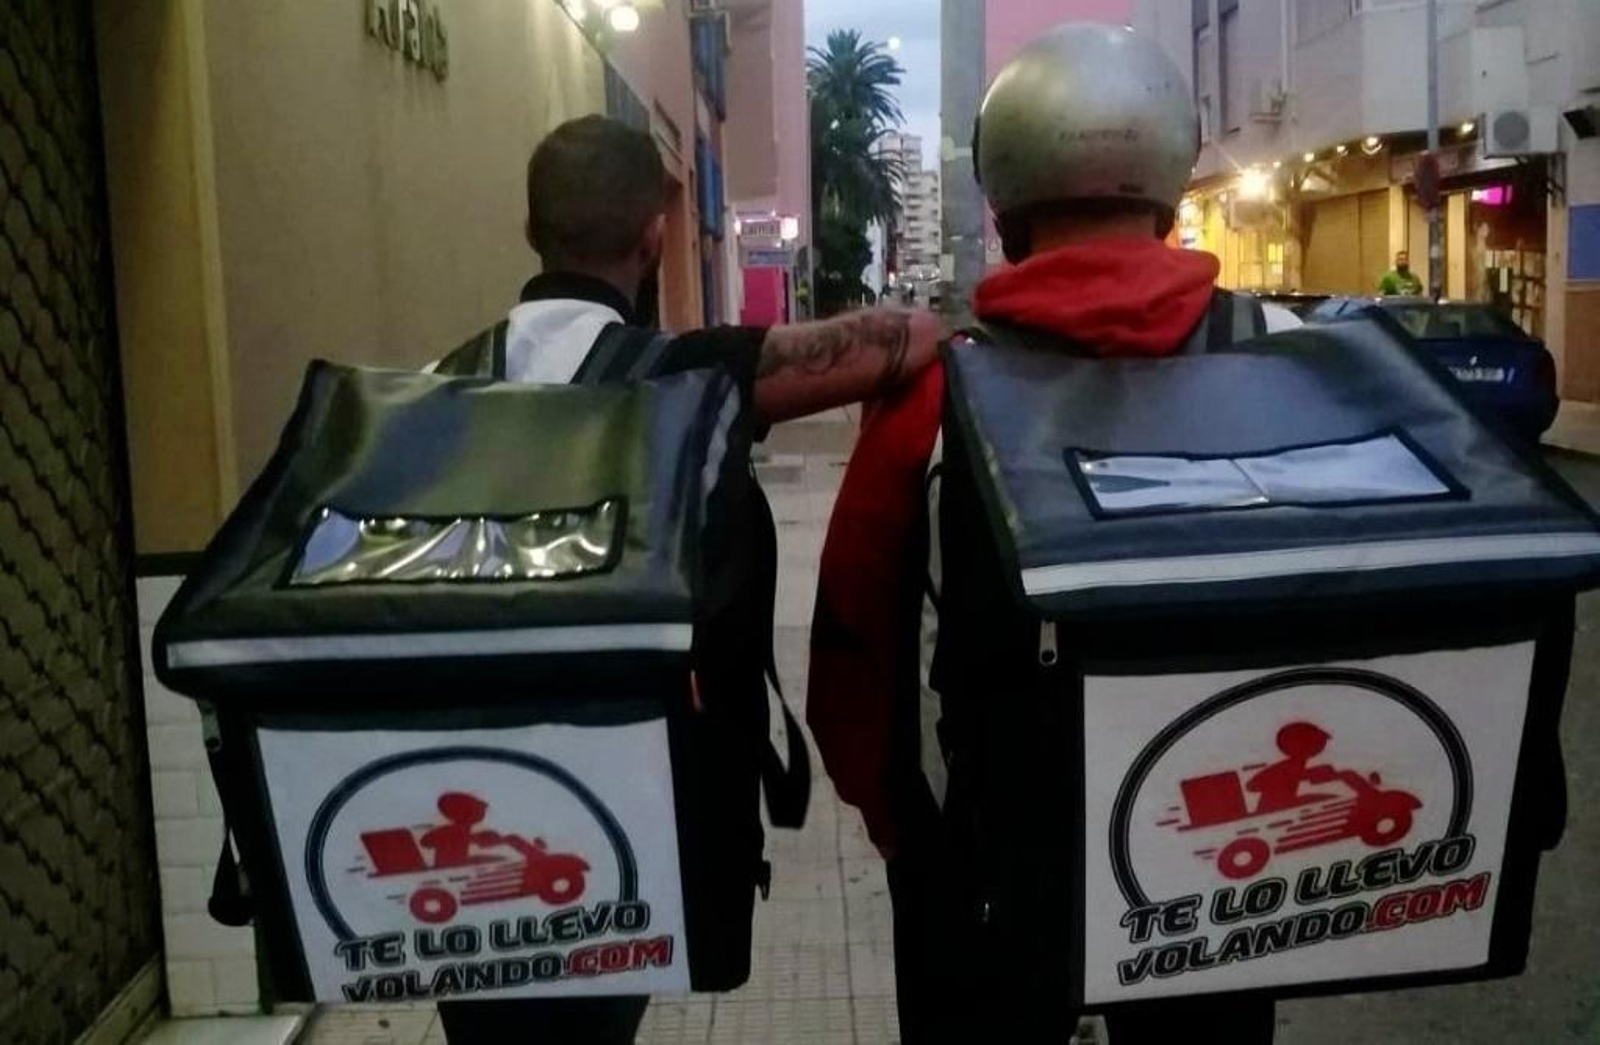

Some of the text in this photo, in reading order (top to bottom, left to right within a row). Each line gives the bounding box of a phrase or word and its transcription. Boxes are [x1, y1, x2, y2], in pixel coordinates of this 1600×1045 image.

[1118, 872, 1491, 986] VOLANDO.COM
[1120, 834, 1476, 943] TE LO LLEVO
[335, 901, 650, 970] TE LO LLEVO
[343, 937, 674, 1002] VOLANDO.COM
